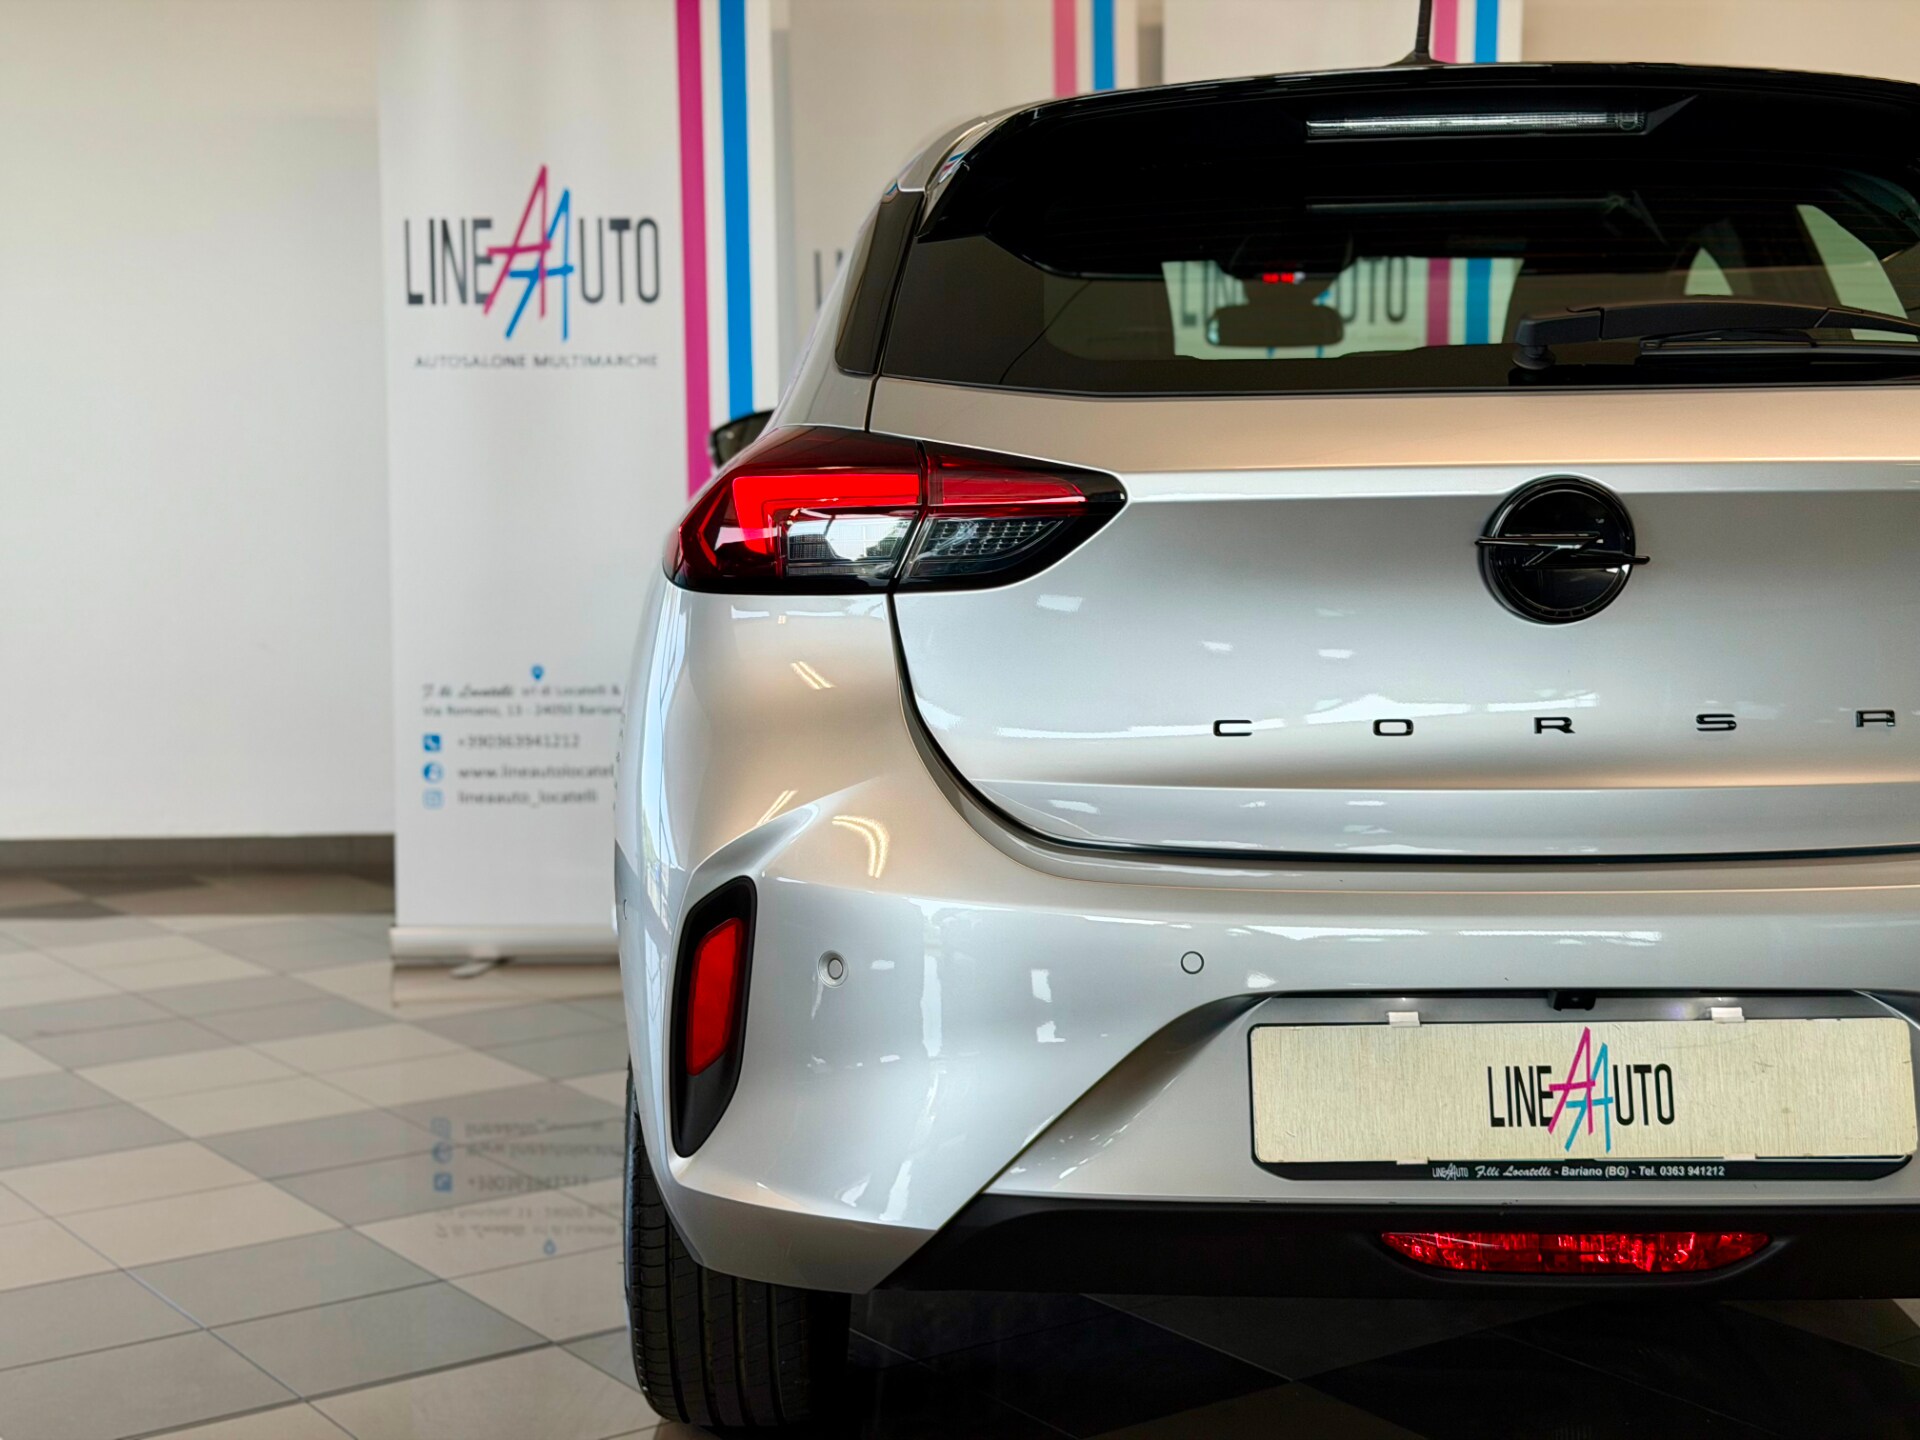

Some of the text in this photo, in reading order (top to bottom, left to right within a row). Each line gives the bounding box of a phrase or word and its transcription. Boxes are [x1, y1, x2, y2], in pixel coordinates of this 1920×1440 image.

[414, 354, 658, 369] AUTOSALONE MULTIMARCHE
[1213, 709, 1895, 737] CORSA
[1503, 1165, 1552, 1177] Locatelli
[1561, 1166, 1602, 1176] Bariano
[1605, 1166, 1629, 1178] (BG)
[1639, 1166, 1657, 1176] Tel.
[1660, 1166, 1685, 1176] 0363
[1687, 1166, 1725, 1176] 941212
